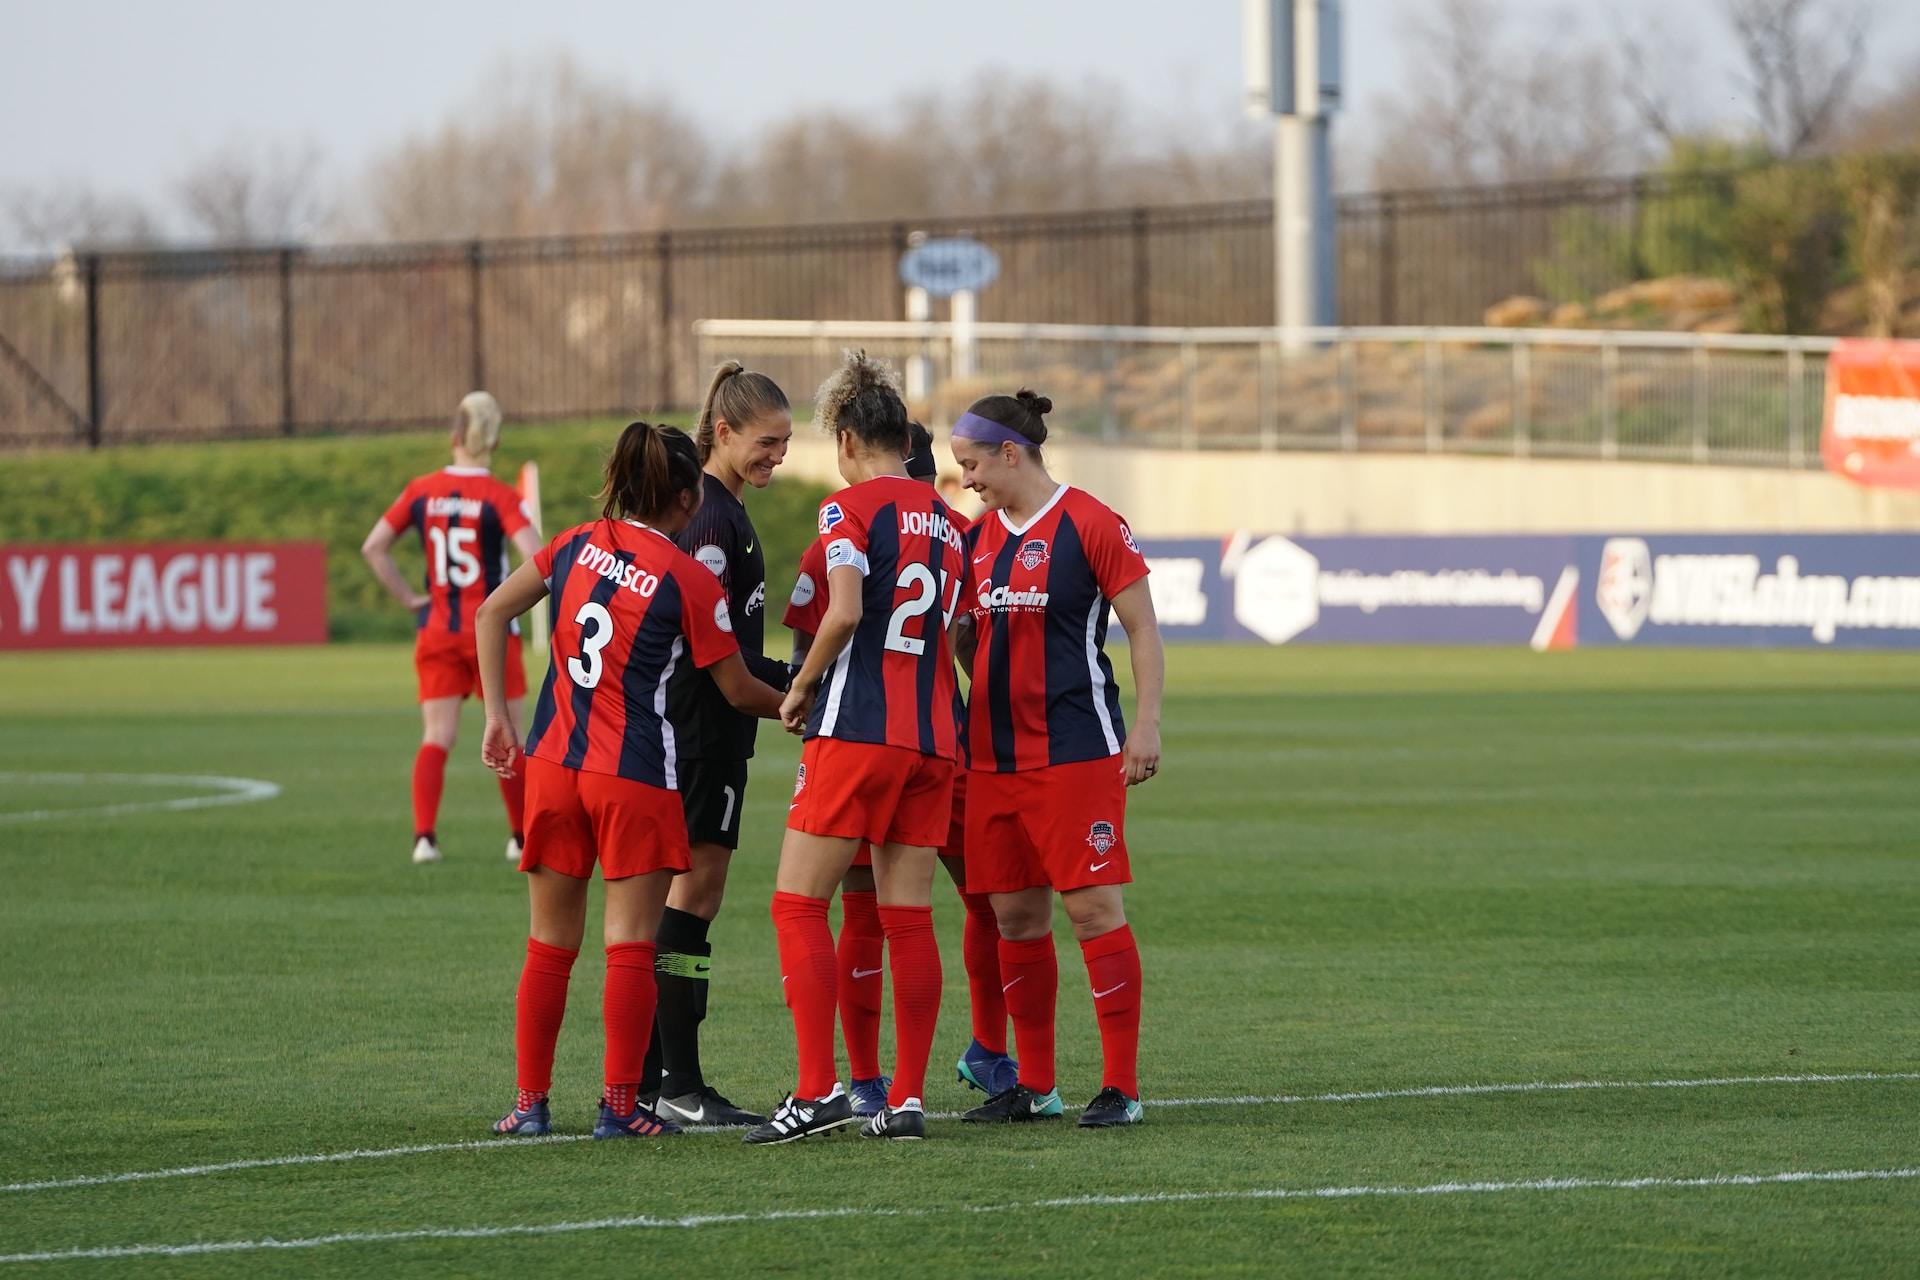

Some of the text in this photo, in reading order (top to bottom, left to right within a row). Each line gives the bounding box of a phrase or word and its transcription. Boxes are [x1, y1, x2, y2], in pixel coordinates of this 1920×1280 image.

[429, 526, 481, 587] 15
[577, 543, 659, 598] DYDASCO
[5, 553, 279, 634] Y LEAGUE
[567, 602, 615, 689] 3
[720, 784, 736, 832] 1
